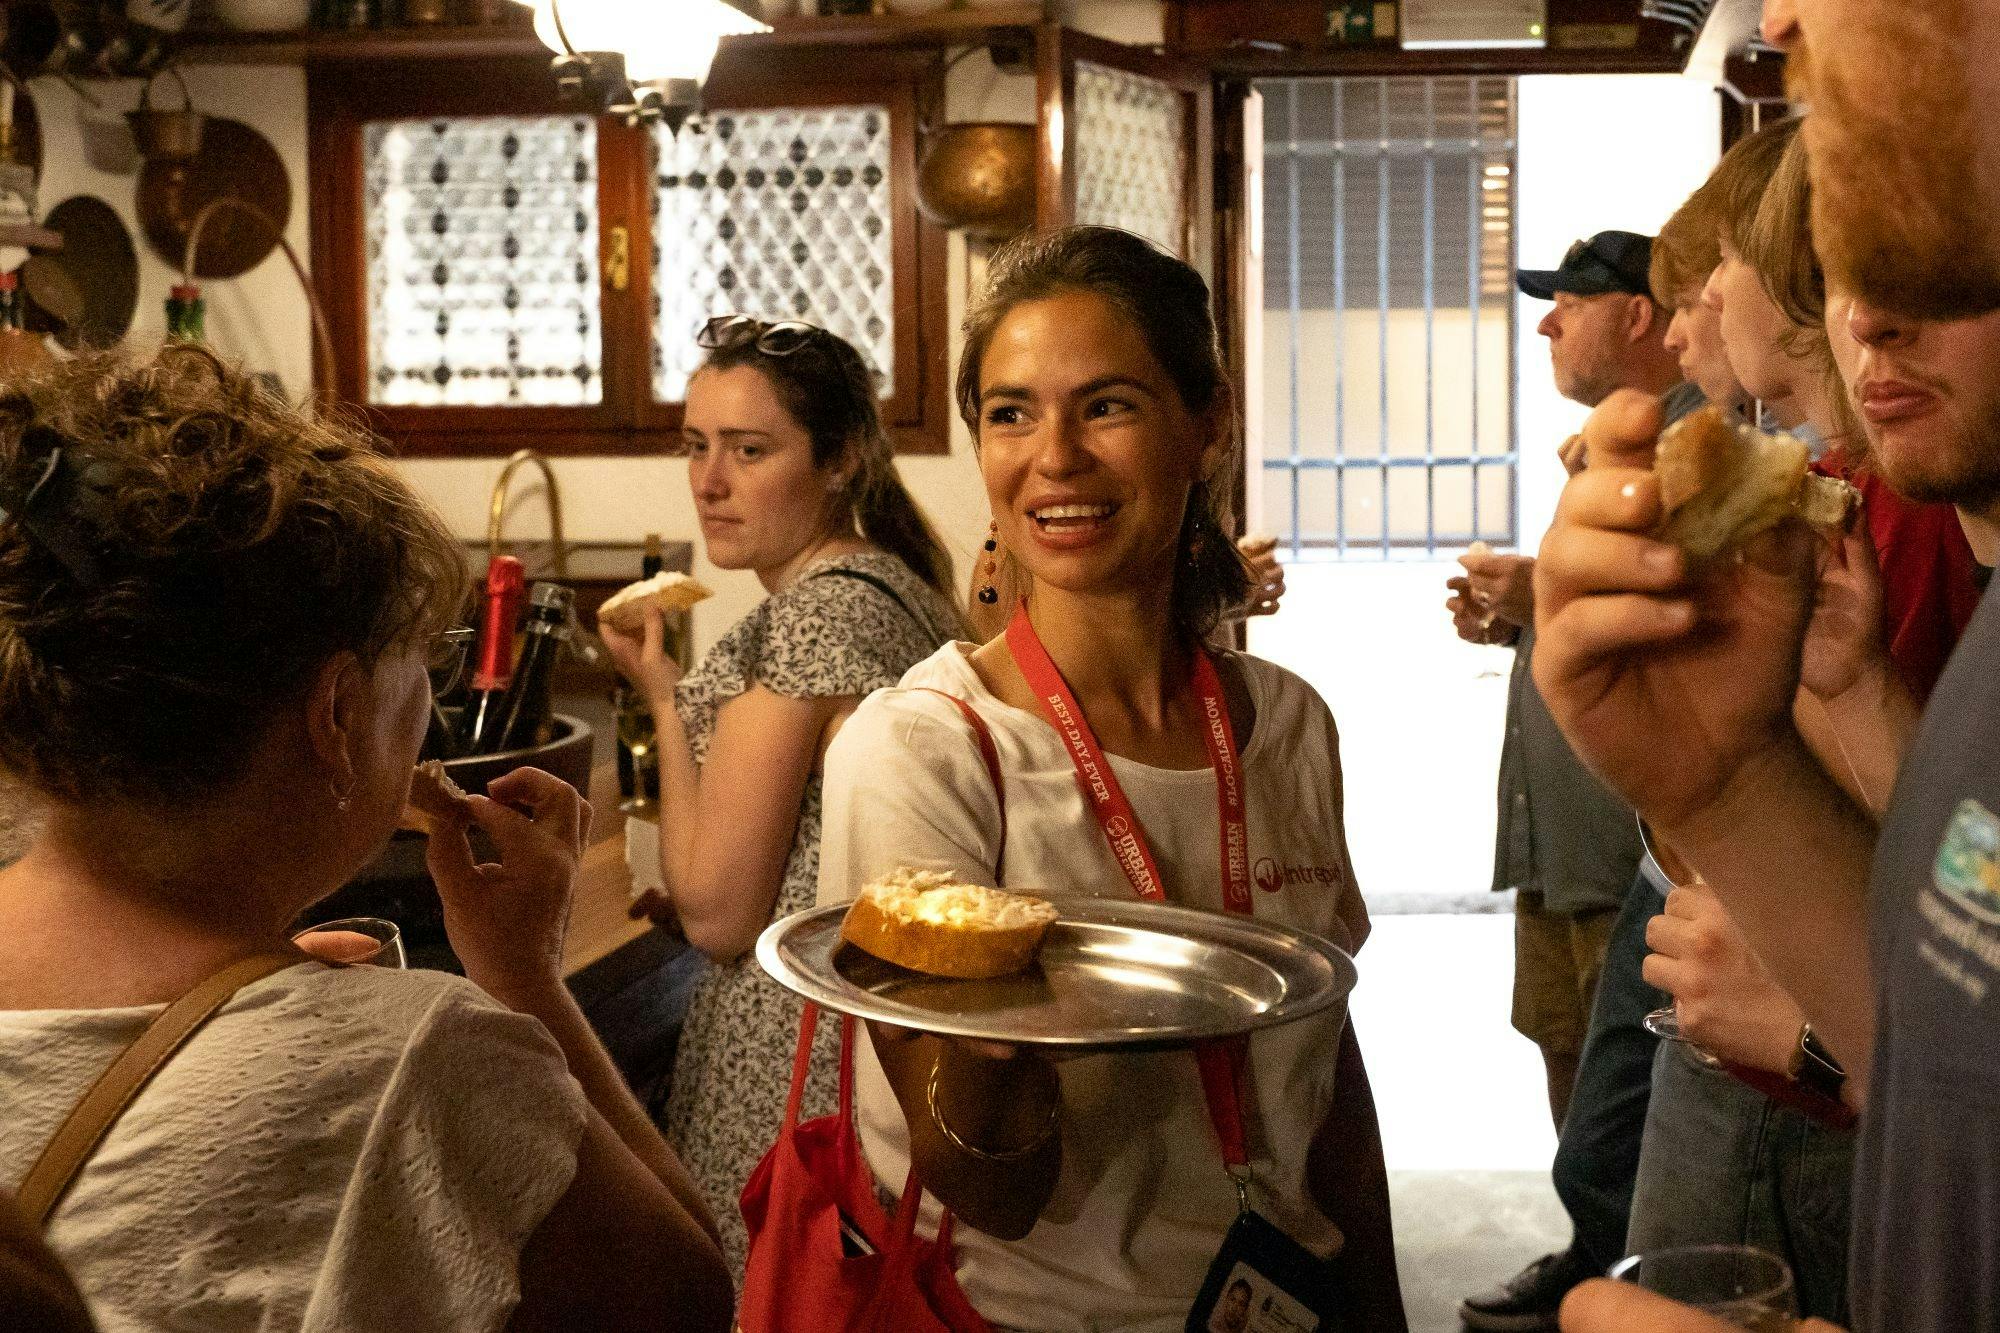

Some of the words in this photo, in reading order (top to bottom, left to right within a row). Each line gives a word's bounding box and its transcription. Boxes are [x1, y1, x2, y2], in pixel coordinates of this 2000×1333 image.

[1204, 696, 1238, 806] #LOCALSKNOW
[1120, 832, 1157, 895] URBAN
[1226, 820, 1243, 882] URBAN
